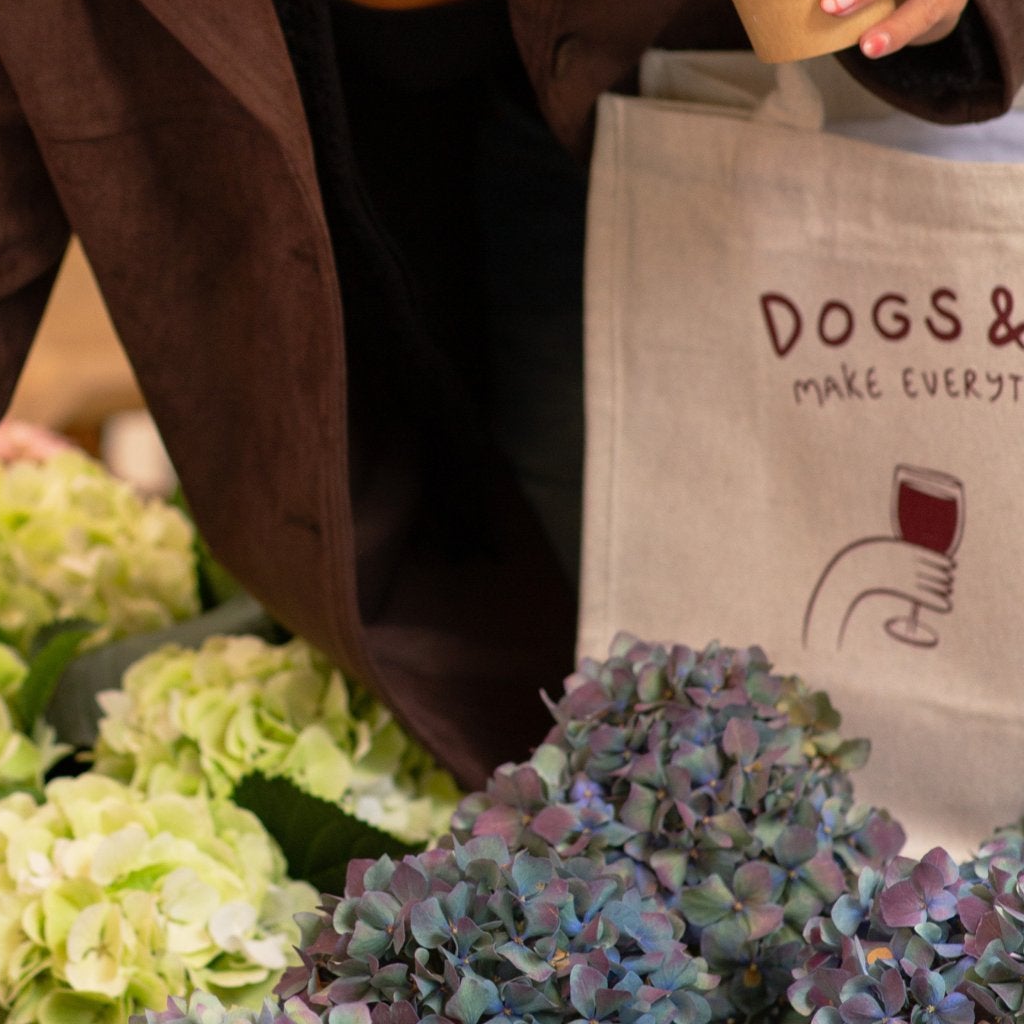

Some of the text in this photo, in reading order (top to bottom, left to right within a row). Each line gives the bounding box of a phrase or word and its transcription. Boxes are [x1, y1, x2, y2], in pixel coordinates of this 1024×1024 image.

[760, 284, 1024, 359] DOGS &
[792, 362, 883, 407] MAKE
